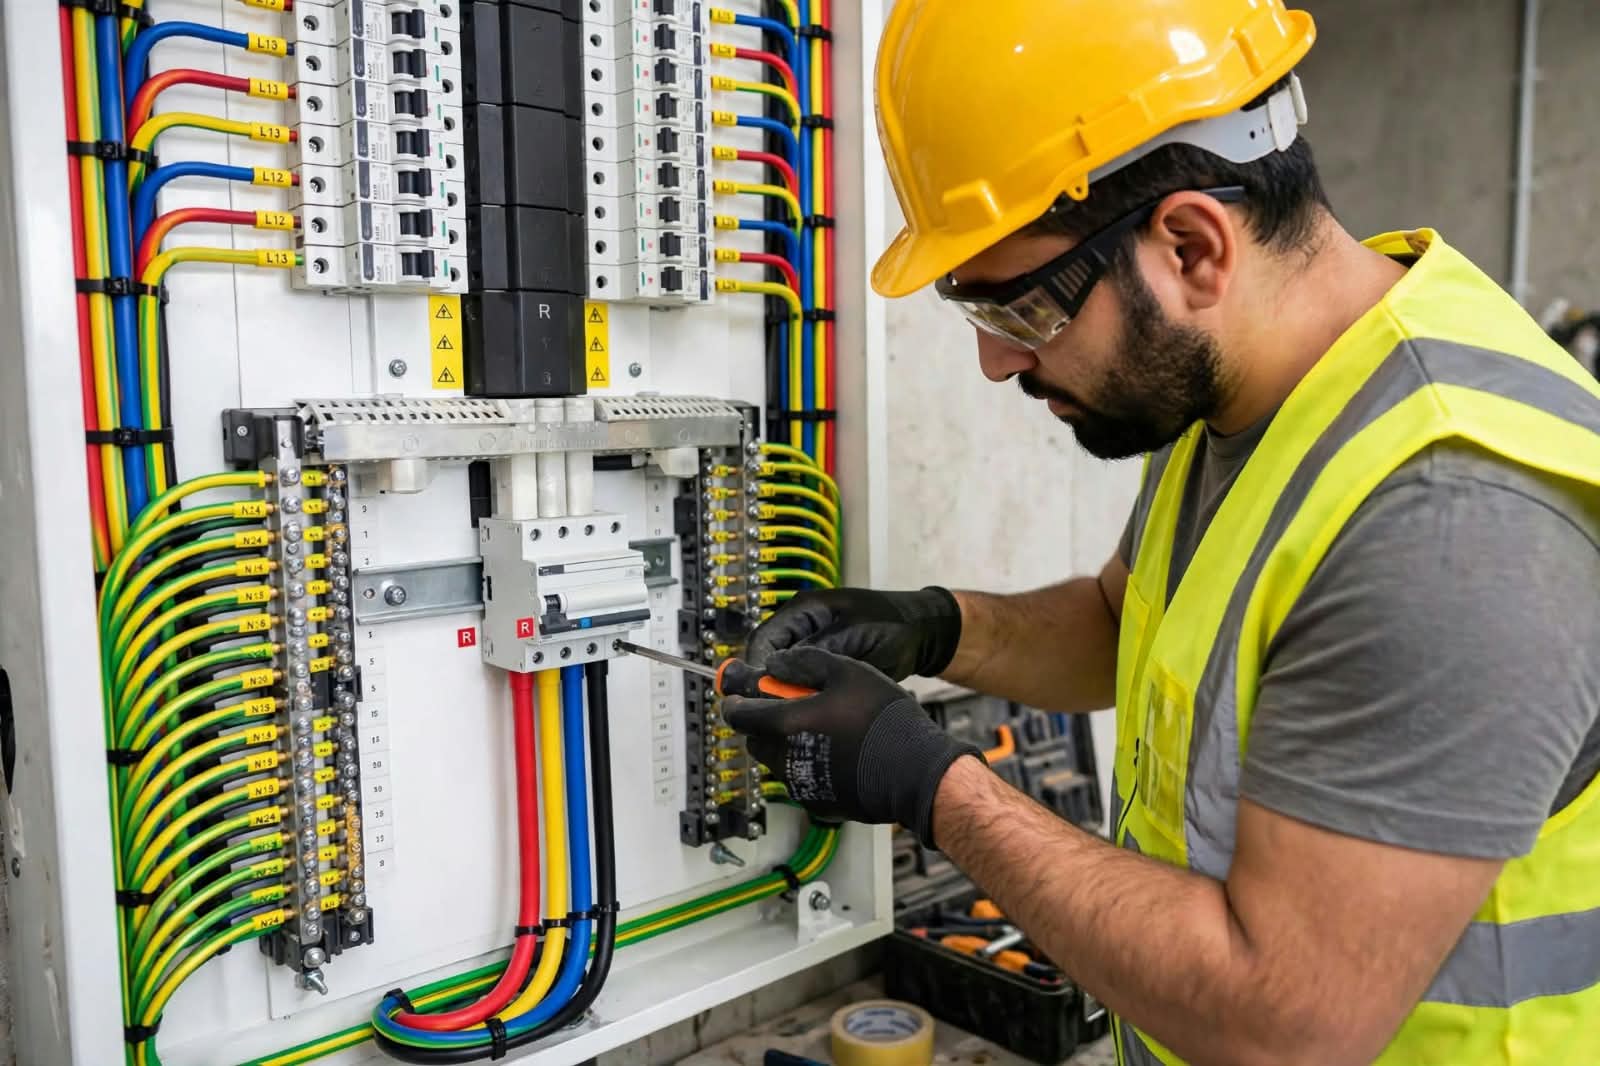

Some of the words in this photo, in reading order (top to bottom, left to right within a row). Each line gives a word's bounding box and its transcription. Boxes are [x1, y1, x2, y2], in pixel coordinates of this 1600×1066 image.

[257, 38, 278, 50] L13
[259, 83, 279, 95] L13
[260, 126, 281, 138] L13
[262, 172, 284, 183] L12
[265, 214, 286, 226] L12
[266, 252, 288, 265] L13
[538, 303, 551, 319] R
[520, 621, 529, 634] R
[461, 631, 471, 643] R
[256, 814, 276, 825] N24
[260, 917, 279, 928] N24
